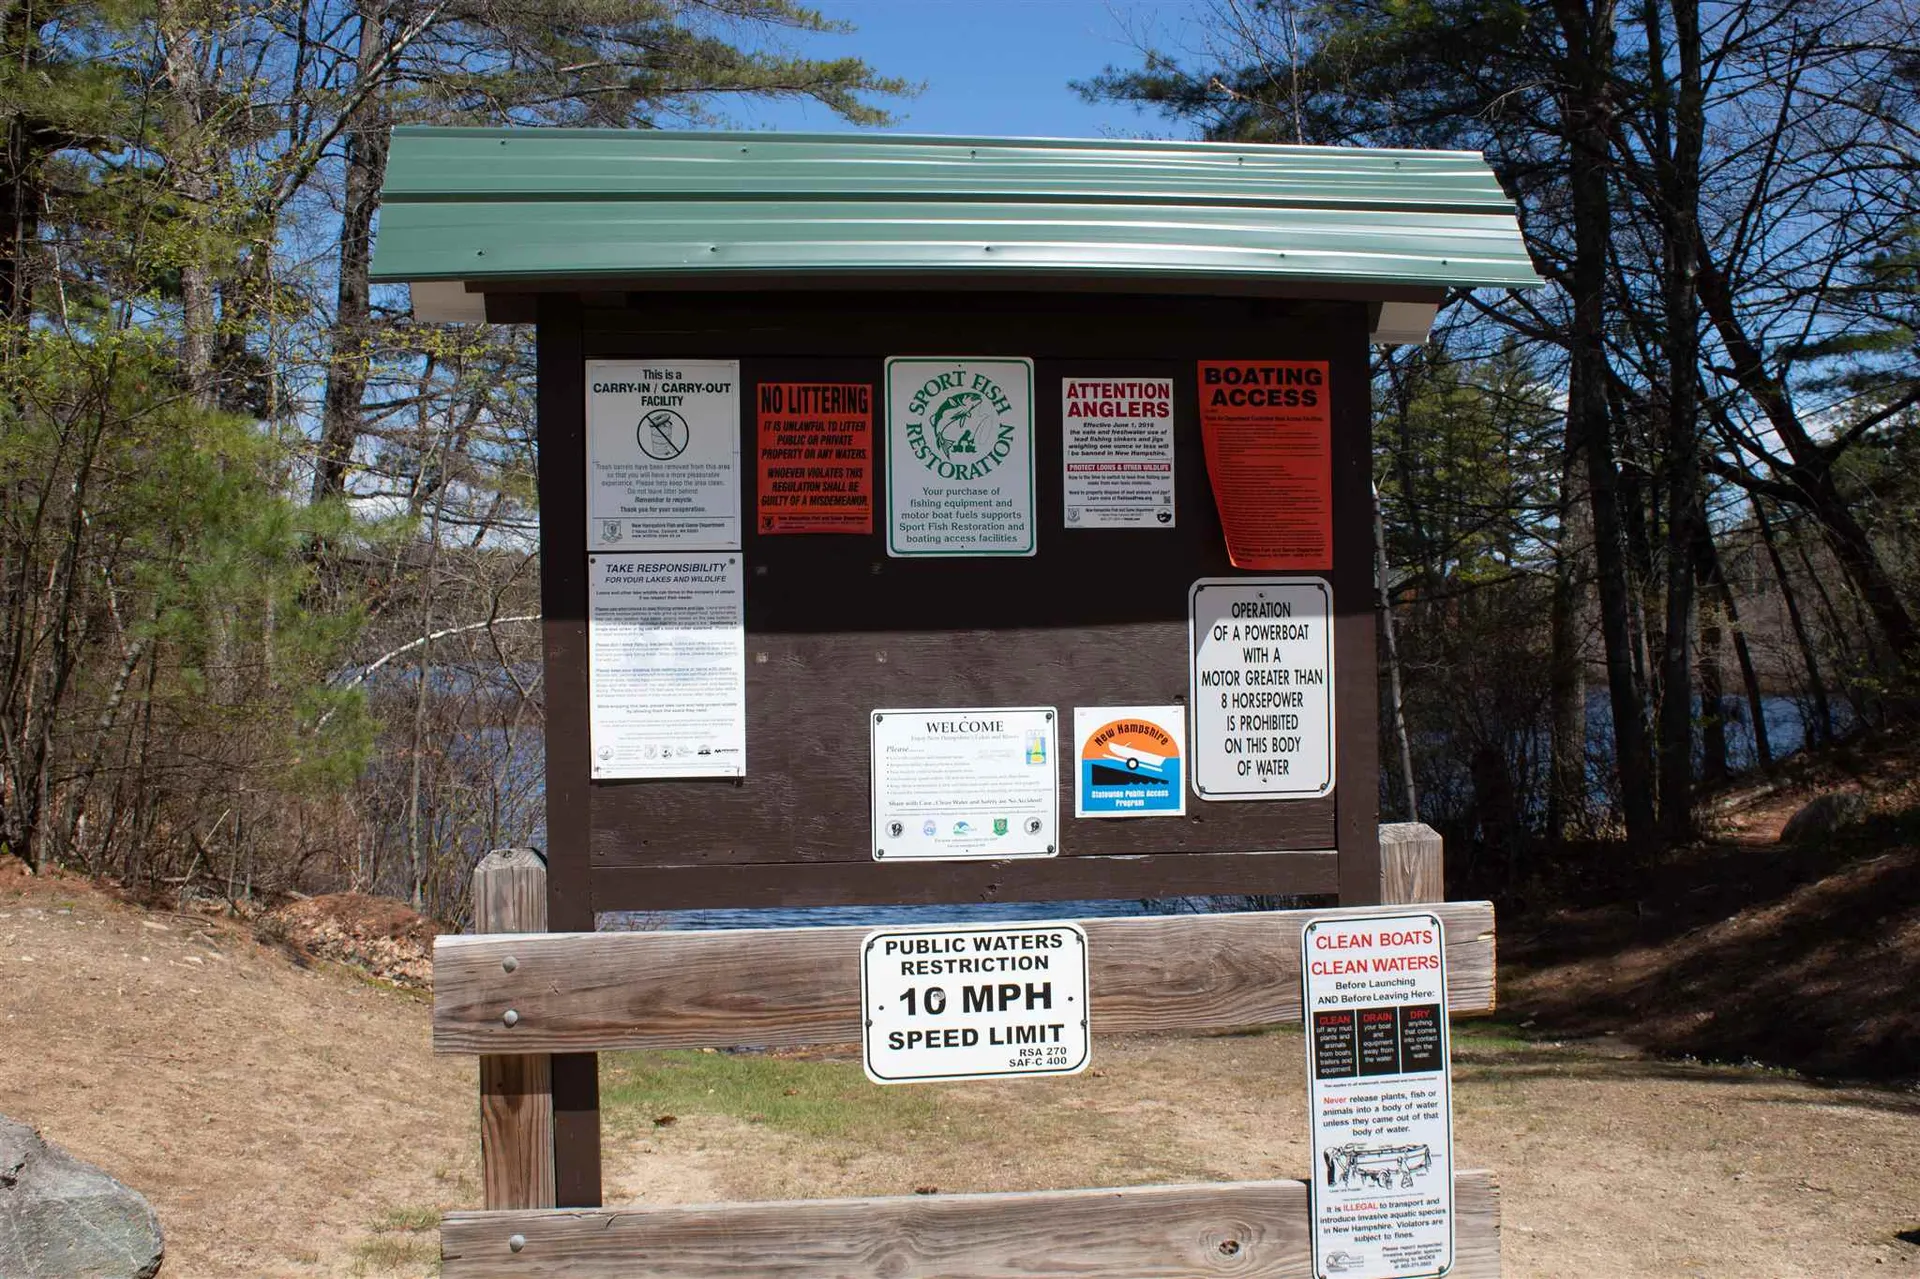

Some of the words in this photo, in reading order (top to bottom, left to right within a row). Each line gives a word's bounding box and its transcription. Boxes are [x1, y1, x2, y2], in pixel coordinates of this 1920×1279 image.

[643, 369, 662, 380] This
[1205, 367, 1323, 385] BOATING
[593, 383, 650, 393] CARRY-IN
[662, 383, 731, 393] CARRY-OUT
[909, 370, 966, 416] SPORT
[971, 374, 1012, 415] FISH
[1067, 382, 1170, 399] ATTENTION
[641, 396, 683, 406] FACILITY
[762, 386, 782, 414] NO
[788, 386, 868, 414] LITTERING
[1211, 388, 1318, 407] ACCESS
[1068, 401, 1170, 418] ANGLERS
[764, 421, 772, 431] IT
[774, 421, 781, 431] IS
[783, 421, 825, 431] UNLAWFUL
[828, 421, 838, 431] TO
[840, 421, 865, 431] LITTER
[777, 435, 805, 445] PUBLIC
[807, 435, 818, 445] OR
[820, 435, 853, 445] PRIVATE
[762, 449, 803, 459] PROPERTY
[805, 449, 817, 459] OR
[817, 449, 833, 459] ANY
[906, 423, 1015, 480] RESTORATION
[768, 468, 805, 478] WHOEVER
[808, 468, 844, 478] VIOLATES
[846, 468, 863, 478] THIS
[772, 482, 820, 492] REGULATION
[822, 482, 846, 492] SHALL
[849, 482, 860, 492] BE
[923, 487, 943, 495] Your
[946, 487, 988, 497] purchase
[991, 487, 1000, 495] of
[761, 496, 788, 505] GUILTY
[790, 496, 801, 505] OF
[801, 496, 807, 505] A
[910, 499, 941, 508] fishing
[944, 500, 992, 508] equipment
[996, 499, 1012, 507] and
[981, 512, 1022, 520] supports
[900, 523, 924, 532] Sport
[906, 535, 941, 544] boating
[980, 534, 1017, 542] facilities
[606, 564, 634, 572] TAKE
[637, 563, 726, 572] RESPONSIBILITY
[1232, 602, 1291, 618] OPERATION
[1214, 626, 1228, 641] OF
[1233, 626, 1240, 641] A
[1245, 624, 1309, 640] POWERBOAT
[1243, 648, 1269, 663] WITH
[1273, 647, 1281, 663] A
[1202, 670, 1240, 686] MOTOR
[1245, 670, 1290, 686] GREATER
[1294, 669, 1323, 685] THAN
[1221, 693, 1227, 709] 8
[1233, 692, 1303, 708] HORSEPOWER
[927, 721, 1004, 733] WELCOME
[1227, 716, 1235, 731] IS
[1240, 715, 1298, 731] PROHIBITED
[1095, 728, 1115, 746] New
[1117, 723, 1168, 745] Hampshire
[1225, 738, 1242, 754] ON
[1246, 737, 1267, 753] THIS
[1272, 737, 1301, 752] BODY
[1237, 761, 1251, 776] OF
[1256, 760, 1289, 776] WATER
[885, 938, 965, 955] PUBLIC
[973, 933, 1062, 952] WATERS
[1316, 934, 1372, 950] CLEAN
[1380, 931, 1433, 947] BOATS
[901, 955, 1049, 975] RESTRICTION
[1311, 960, 1368, 975] CLEAN
[1373, 956, 1439, 972] WATERS
[1336, 981, 1366, 990] Before
[1369, 978, 1415, 988] Launching
[900, 986, 946, 1016] 10
[962, 982, 1051, 1013] MPH
[1318, 996, 1338, 1005] AND
[1341, 995, 1372, 1003] Before
[1373, 993, 1408, 1002] Leaving
[1320, 1016, 1351, 1025] CLEAN
[1363, 1012, 1392, 1022] DRAIN
[888, 1028, 979, 1050] SPEED
[990, 1024, 1064, 1046] LIMIT
[1019, 1048, 1043, 1057] RSA
[1046, 1047, 1067, 1056] 270
[1009, 1058, 1043, 1068] SAF-C
[1046, 1057, 1067, 1066] 400
[1324, 1096, 1346, 1104] Never
[1381, 1092, 1408, 1102] plants,
[1410, 1090, 1425, 1098] fish
[1323, 1108, 1353, 1116] animals
[1382, 1104, 1401, 1112] body
[1352, 1118, 1368, 1126] they
[1353, 1128, 1372, 1137] body
[1343, 1203, 1378, 1212] ILLEGAL
[1389, 1200, 1424, 1210] transport
[1320, 1215, 1356, 1224] introduce
[1390, 1210, 1416, 1219] aquatic
[1418, 1209, 1446, 1217] species
[1351, 1223, 1393, 1233] Hampshire.
[1397, 1220, 1430, 1228] Violators
[1354, 1234, 1381, 1243] subject
